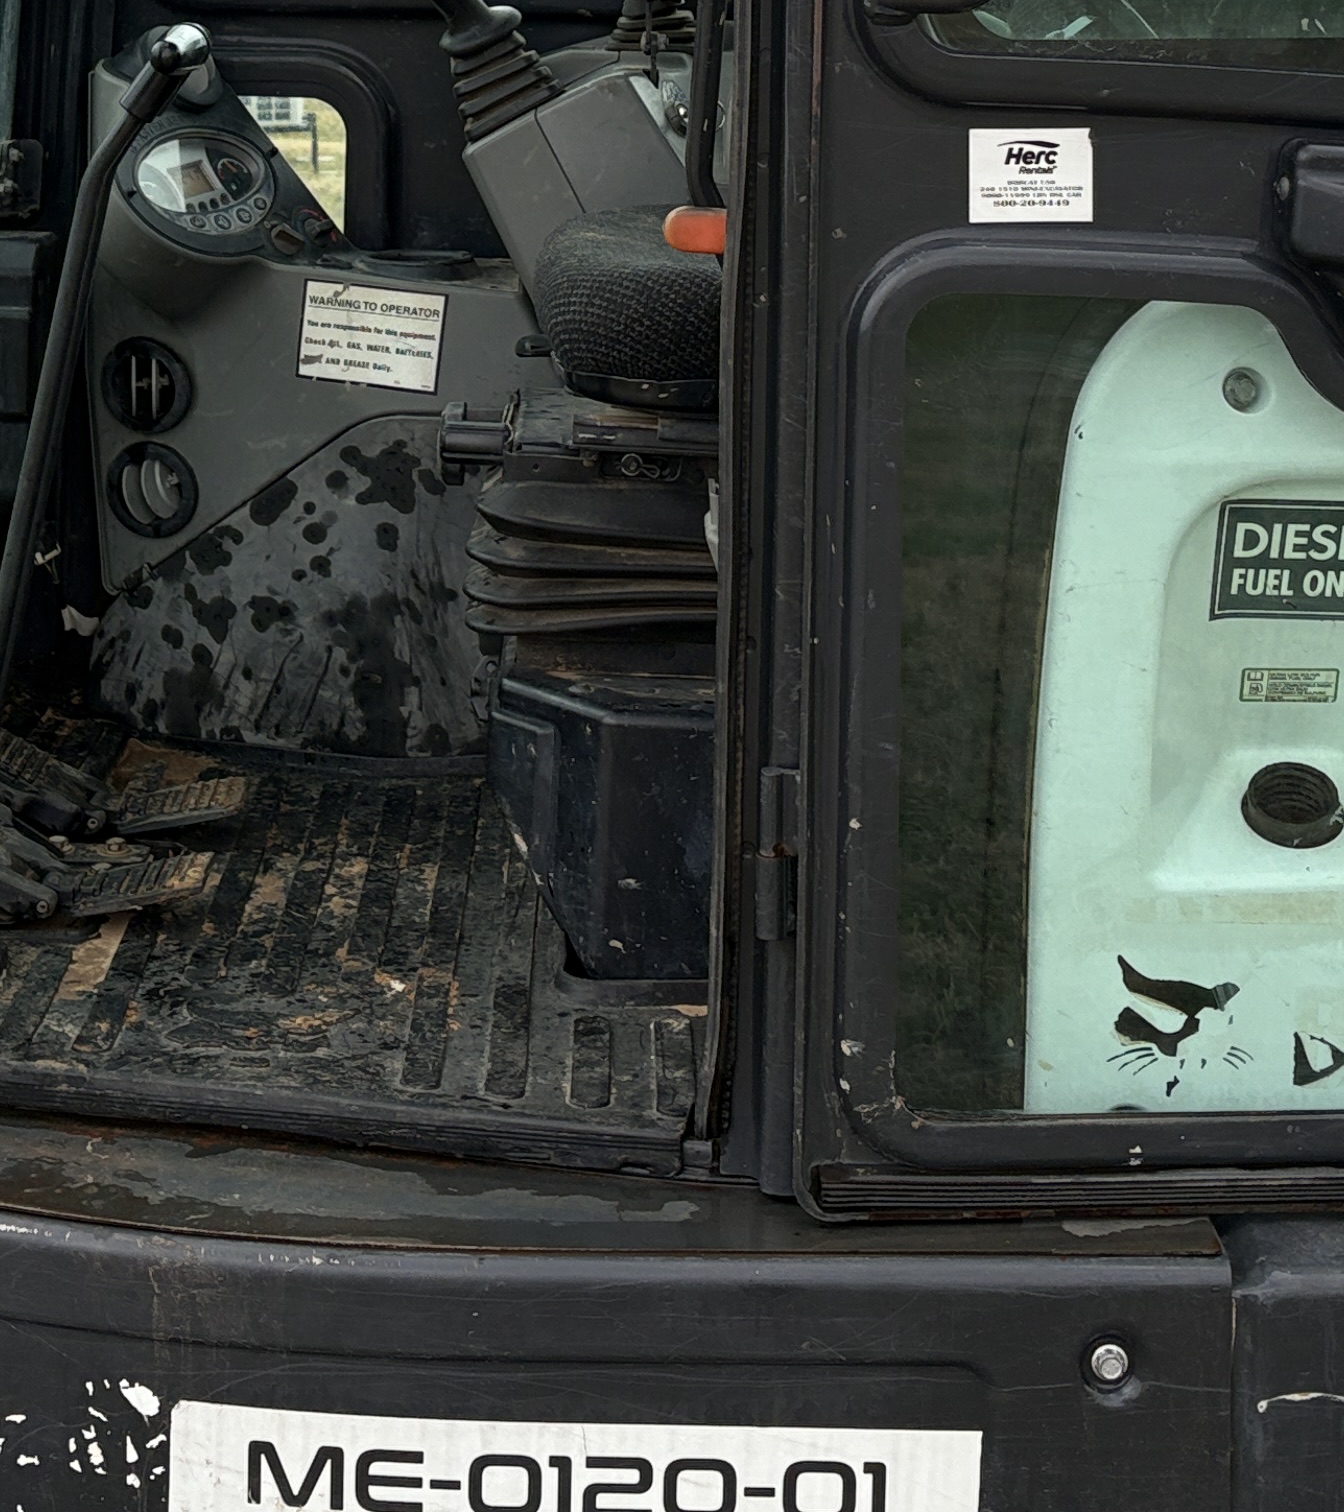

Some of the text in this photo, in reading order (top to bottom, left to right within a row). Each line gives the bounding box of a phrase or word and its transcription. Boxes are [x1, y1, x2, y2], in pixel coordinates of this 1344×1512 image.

[1004, 146, 1058, 165] Herc
[309, 295, 441, 319] WARNING TO OPERATOR
[385, 327, 398, 337] this
[325, 357, 341, 366] AND
[1230, 568, 1294, 597] FUEL
[247, 1440, 886, 1512] ME-0120-01
